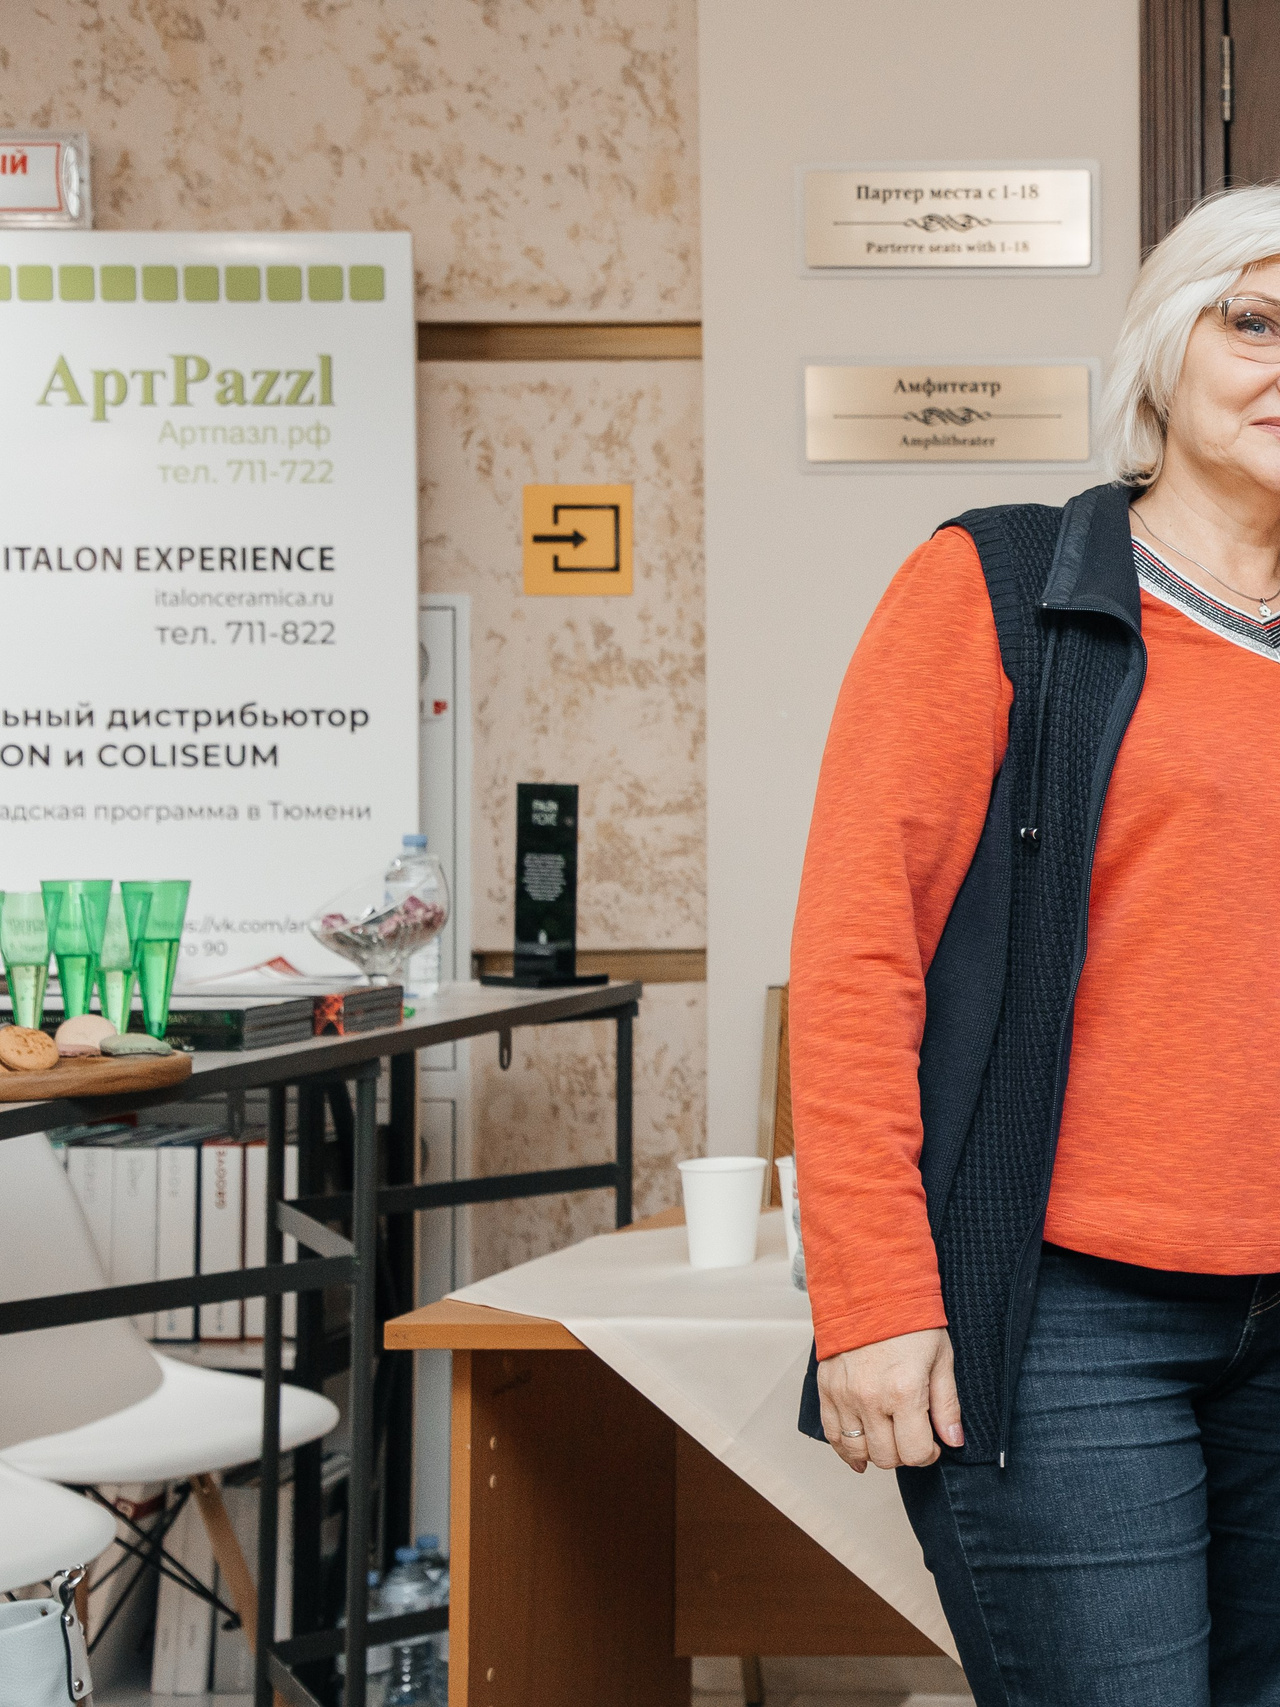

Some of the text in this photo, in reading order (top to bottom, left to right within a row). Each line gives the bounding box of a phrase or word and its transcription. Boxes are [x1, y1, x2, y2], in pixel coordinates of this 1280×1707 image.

[857, 185, 925, 206] Партер
[931, 188, 984, 201] места
[988, 189, 998, 201] с
[866, 242, 926, 255] Parterre
[929, 243, 963, 255] seats
[966, 241, 998, 254] with
[894, 378, 1003, 399] Амфитеатр
[157, 420, 333, 451] Артпазл.рф
[901, 434, 997, 452] Amphitheater
[157, 458, 336, 486] тел. 711-722
[4, 546, 336, 573] ITALON EXPERIENCE
[155, 589, 335, 609] italonceramica.ru
[156, 621, 337, 647] тел. 711-822
[2, 702, 371, 735] ьный дистрибьютор
[0, 744, 279, 769] ON и COLISEUM
[94, 805, 241, 827] программа
[247, 806, 262, 822] в
[270, 802, 373, 822] Тюмени
